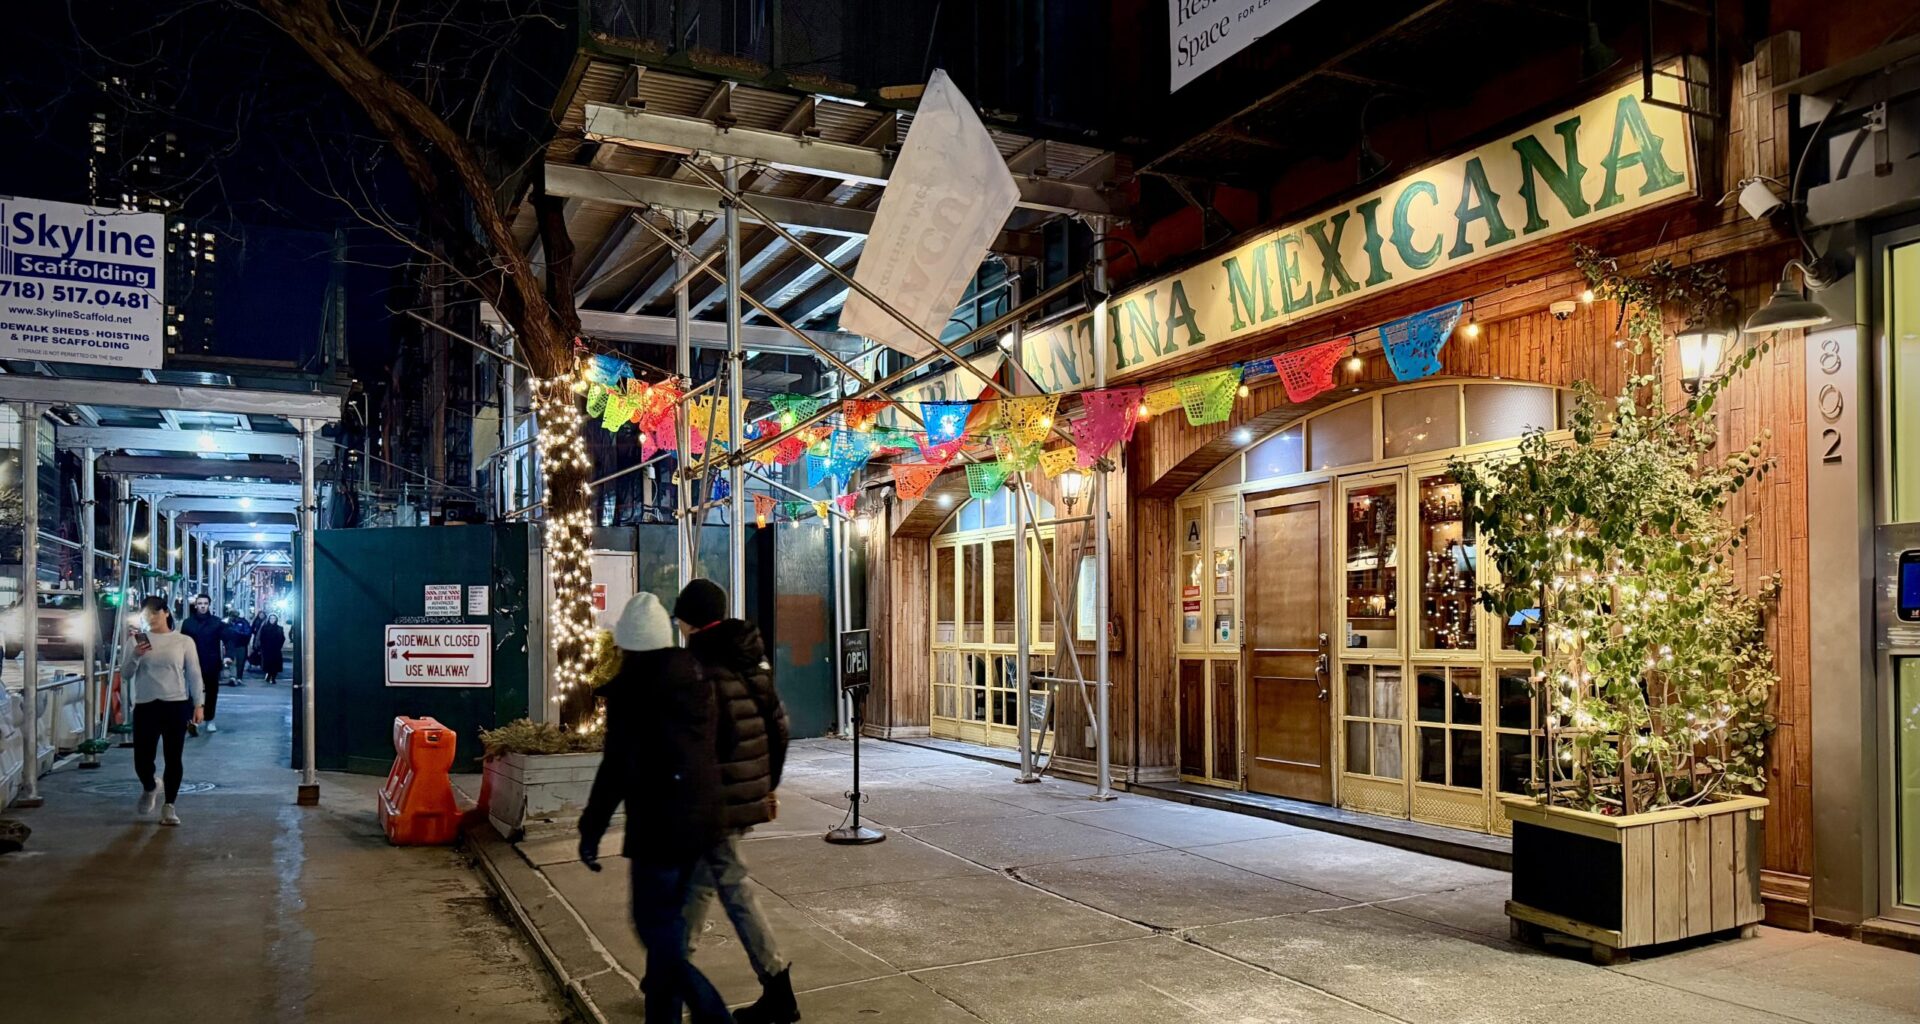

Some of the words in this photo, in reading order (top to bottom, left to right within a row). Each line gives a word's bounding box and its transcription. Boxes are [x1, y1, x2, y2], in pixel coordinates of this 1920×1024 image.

[1177, 16, 1230, 67] Space
[1238, 5, 1255, 22] FOR
[1221, 94, 1686, 332] MEXICANA
[12, 211, 156, 259] Skyline
[20, 256, 149, 287] Scaffolding
[52, 285, 149, 310] 517.0481
[8, 306, 132, 325] www.SkylineScaffold.net
[10, 333, 19, 341] &
[23, 334, 49, 343] PIPE
[52, 337, 130, 350] SCAFFOLDING
[52, 326, 90, 337] SHEDS
[96, 330, 150, 342] HOISTING
[1188, 521, 1200, 542] A
[396, 634, 440, 647] SIDEWALK
[444, 634, 480, 647] CLOSED
[405, 664, 424, 677] USE
[427, 664, 469, 677] WALKWAY
[846, 650, 868, 674] OPEN
